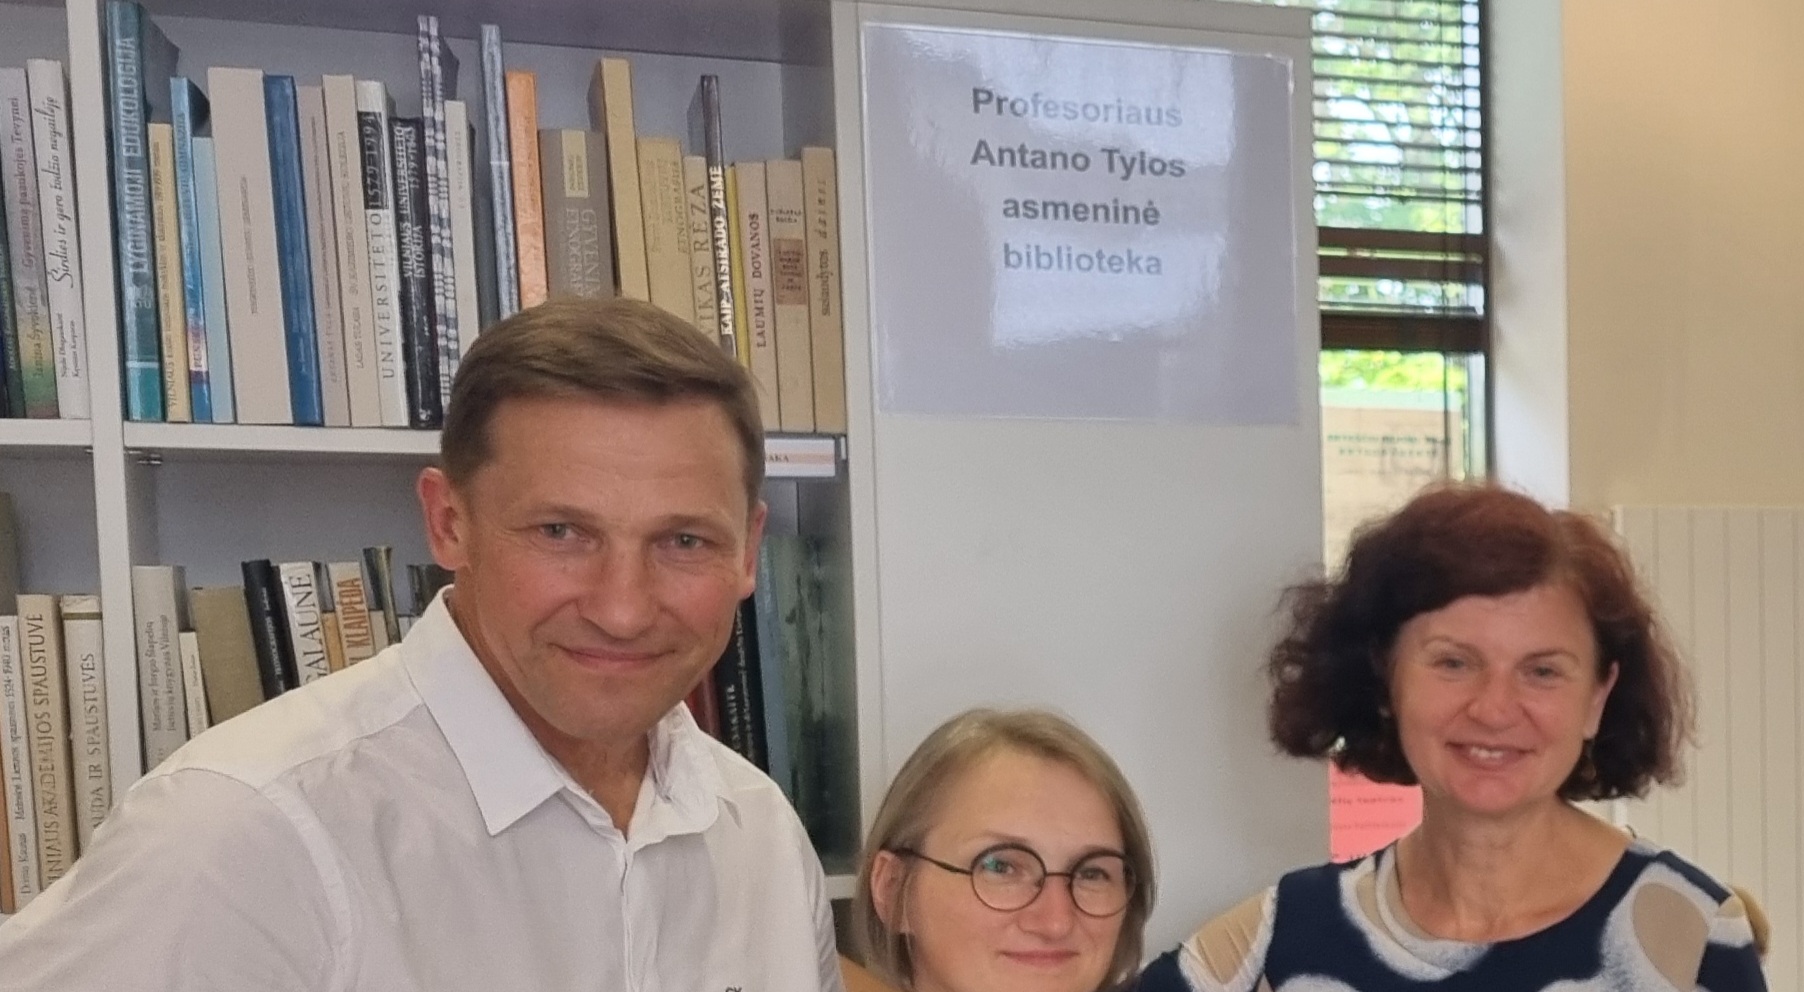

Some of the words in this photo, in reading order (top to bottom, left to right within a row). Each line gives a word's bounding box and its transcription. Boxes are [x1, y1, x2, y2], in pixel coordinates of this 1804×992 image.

[116, 37, 141, 158] EDUKOLOGIJA
[972, 87, 1183, 128] Profesoriaus
[394, 126, 409, 214] UNIVERSITETO
[971, 139, 1091, 172] Antano
[1101, 148, 1186, 180] Tylos
[1002, 197, 1161, 226] asmeninė
[400, 222, 413, 278] VILNIAUS
[412, 225, 426, 278] ISTORIJA
[748, 213, 762, 278] DOVANOS
[1003, 243, 1163, 275] biblioteka
[370, 214, 394, 379] UNIVERSITETO
[336, 578, 370, 648] KLAIPĖDA
[25, 614, 49, 706] SPAUSTUVĖ
[80, 653, 101, 756] SPAUSTUVĖS
[88, 764, 102, 780] IR
